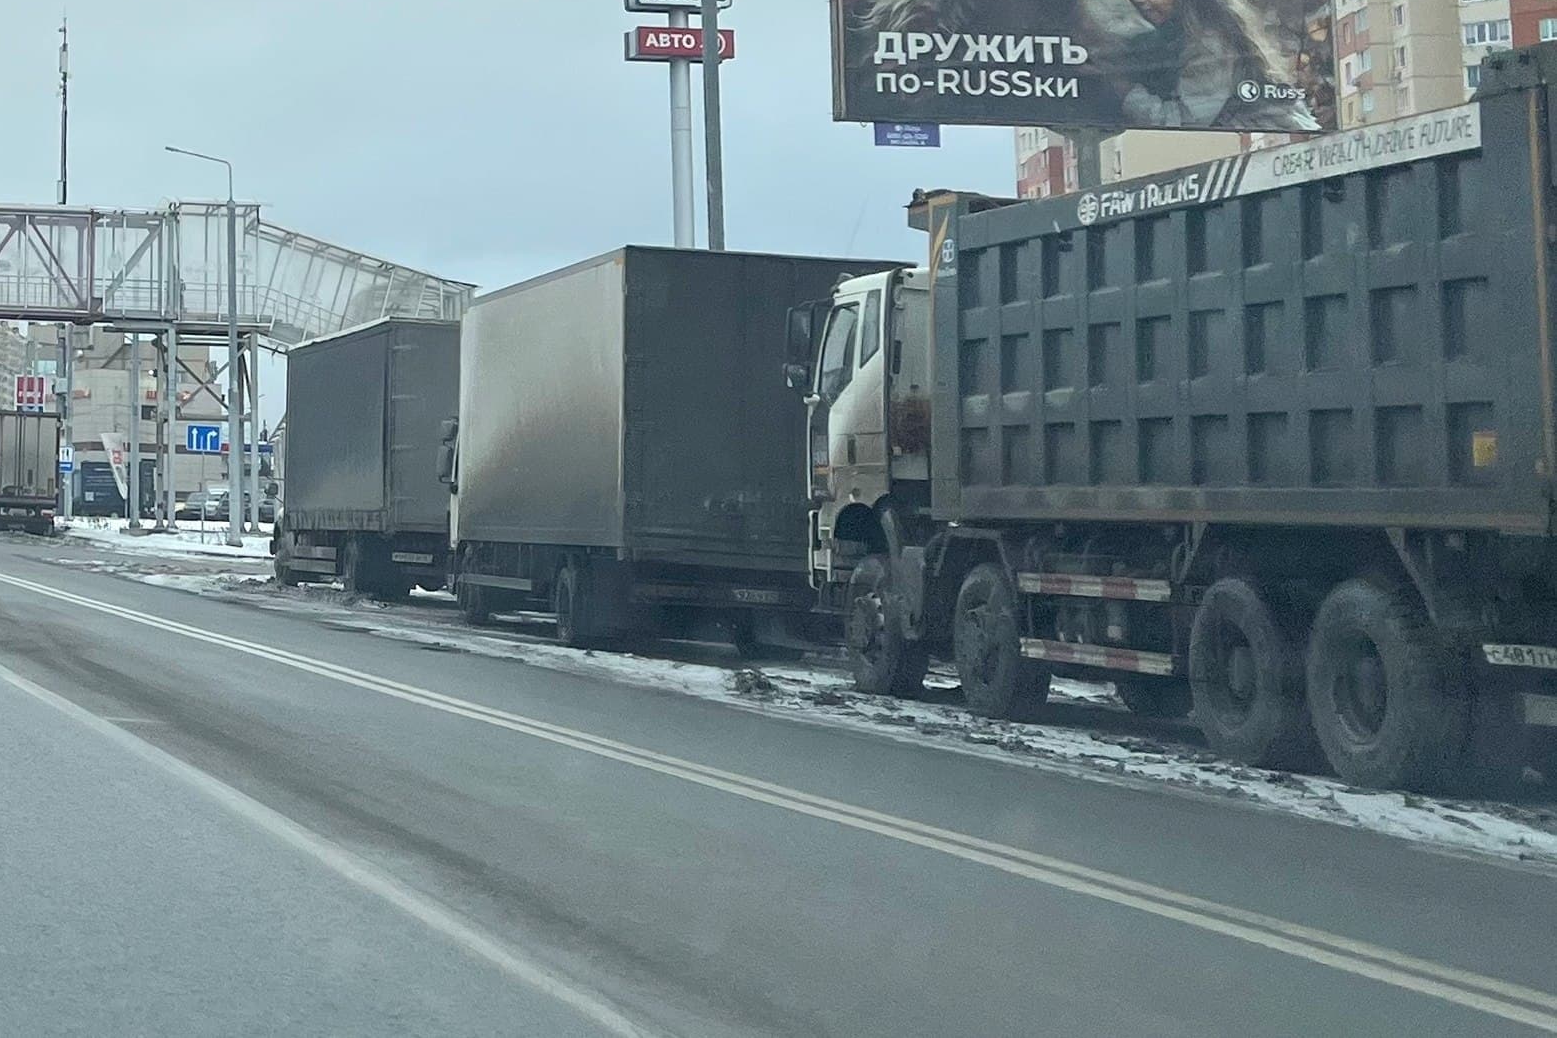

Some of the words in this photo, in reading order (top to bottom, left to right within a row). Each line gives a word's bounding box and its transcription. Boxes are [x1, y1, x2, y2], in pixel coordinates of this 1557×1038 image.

[645, 33, 696, 49] АВТО
[873, 31, 1088, 65] ДРУЖИТЬ
[876, 68, 1080, 98] по-RUSSки
[1263, 83, 1306, 100] Russ
